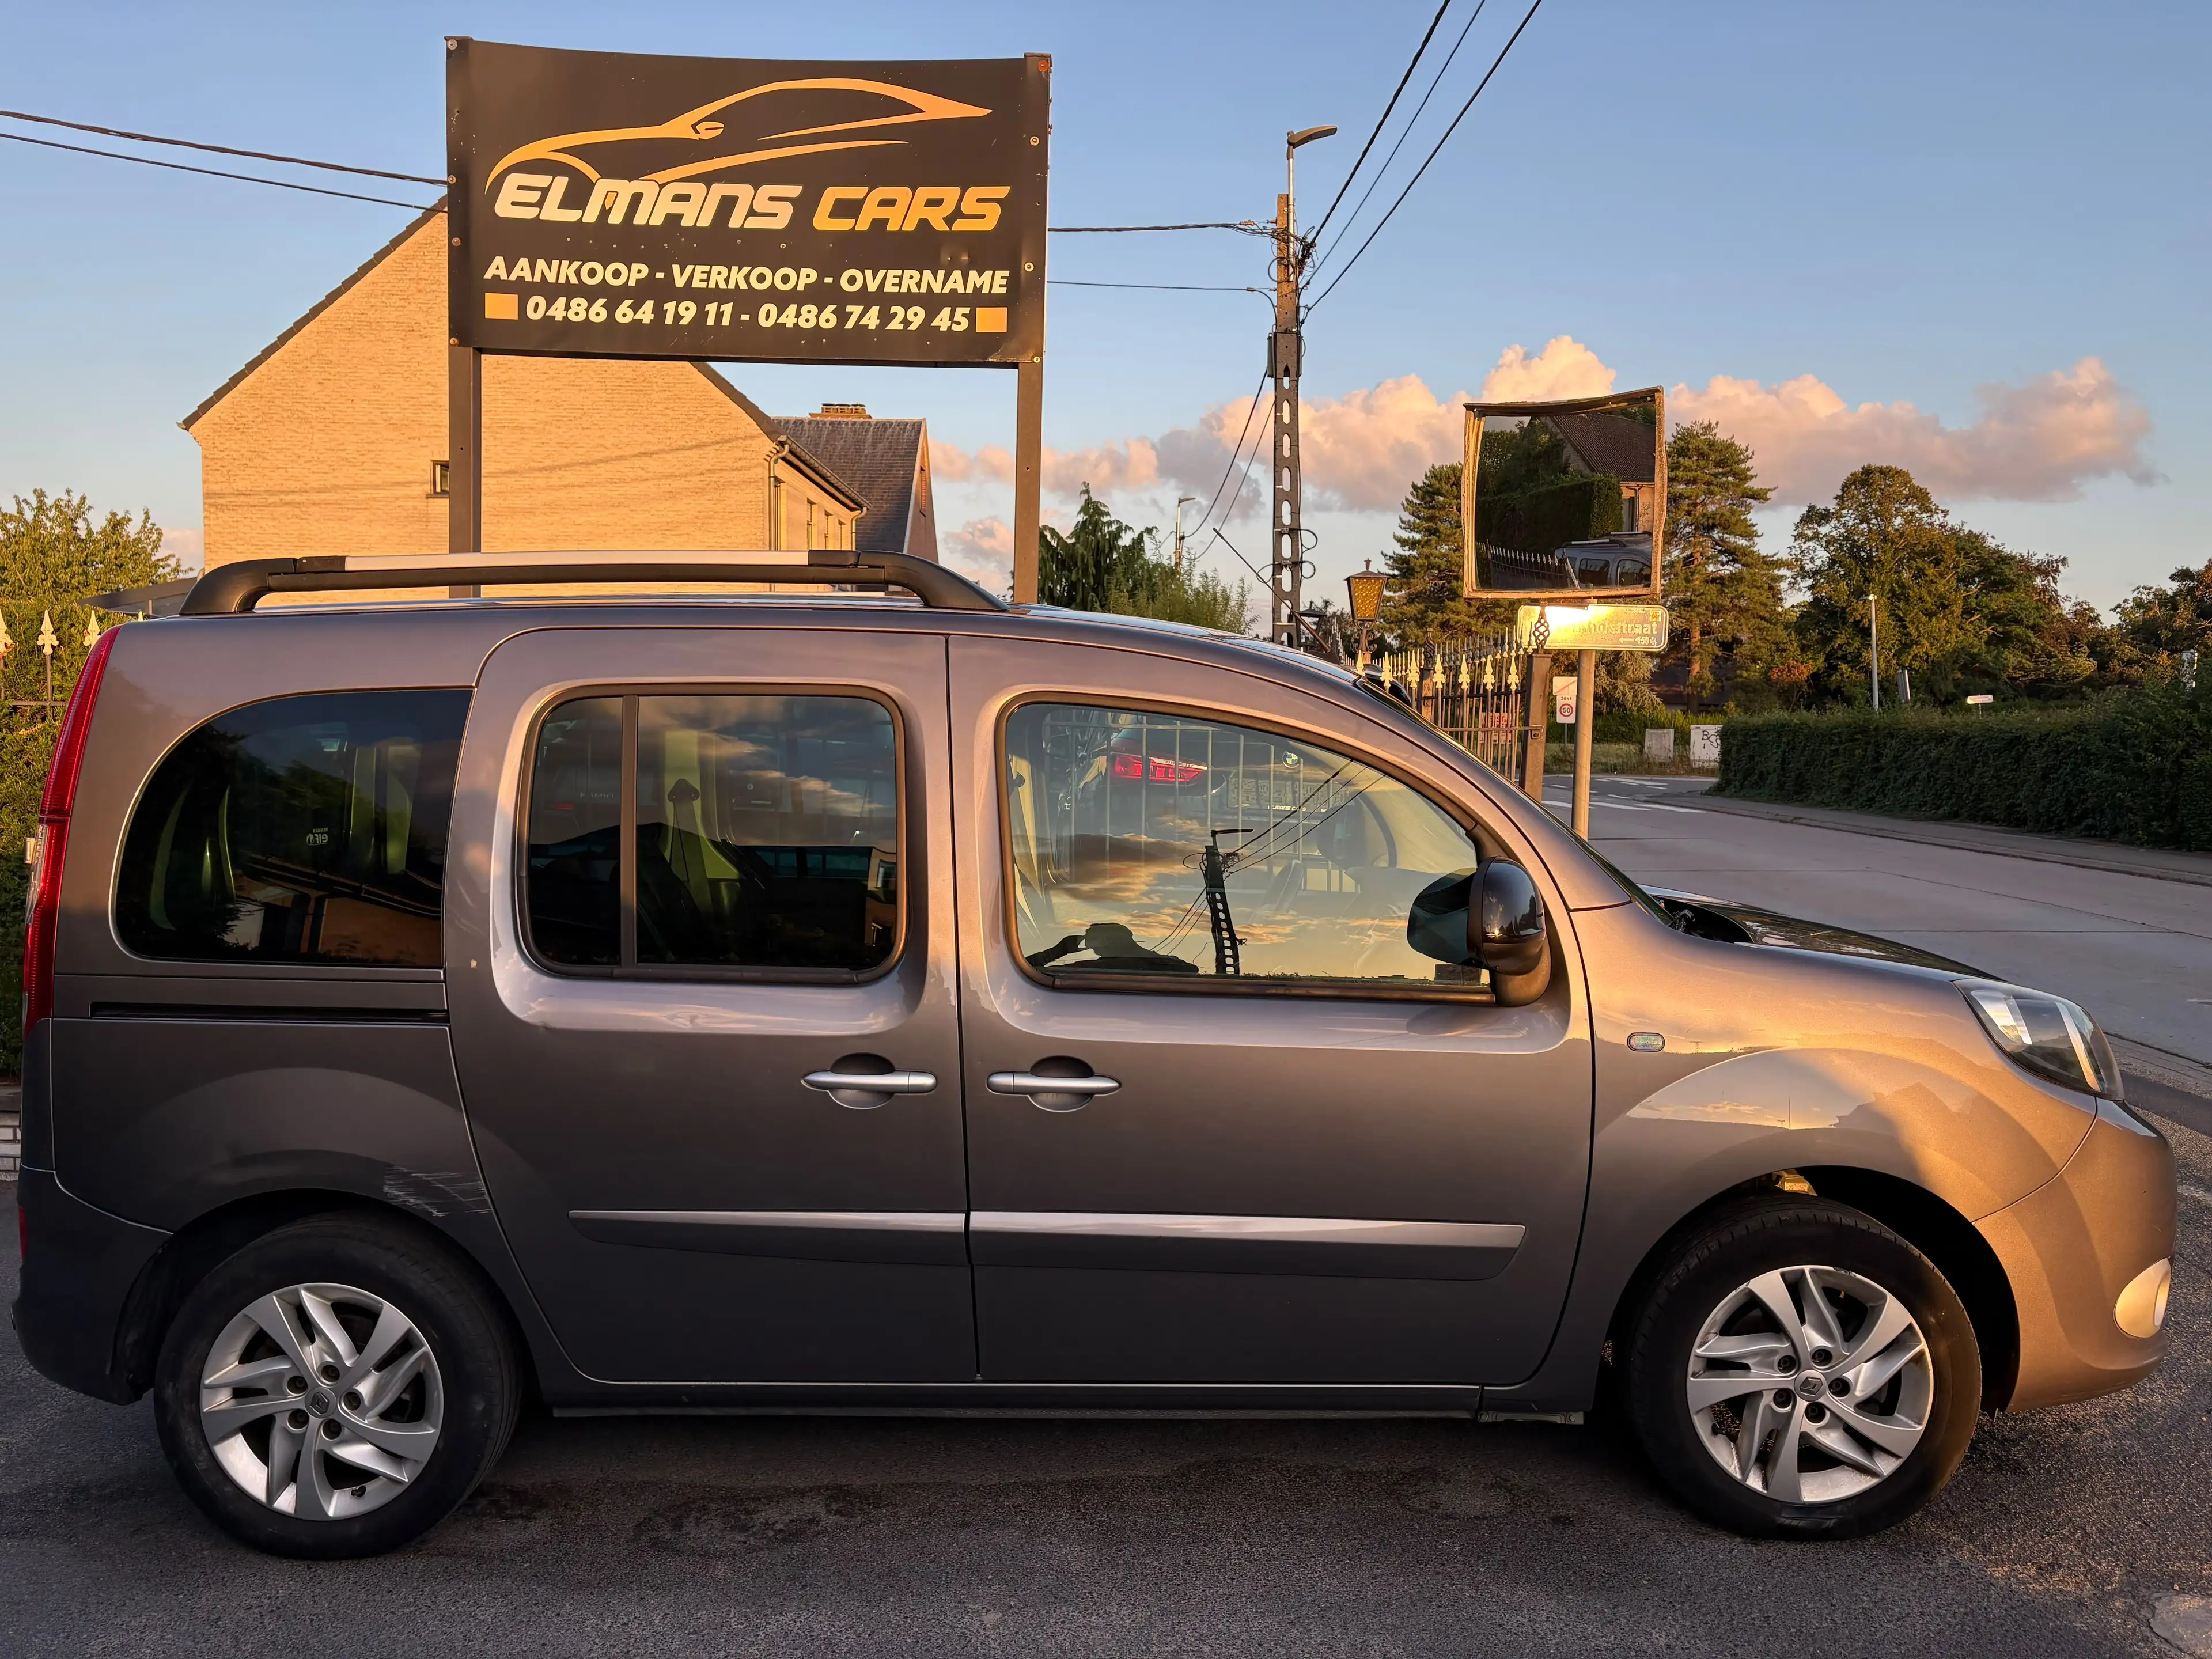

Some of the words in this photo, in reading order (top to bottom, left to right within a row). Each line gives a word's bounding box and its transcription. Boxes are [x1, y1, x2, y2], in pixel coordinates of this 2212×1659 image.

[494, 172, 803, 229] ELMANS
[812, 186, 1010, 231] CARS
[483, 256, 649, 287] AANKOOP
[671, 264, 818, 291] VERKOOP
[839, 268, 1010, 294] OVERNAME
[525, 295, 608, 323] 0486
[614, 299, 655, 324] 64
[662, 300, 697, 325] 19
[704, 301, 734, 327] 11
[757, 302, 838, 329] 0486
[843, 305, 880, 329] 74
[885, 305, 926, 331] 29
[930, 306, 971, 332] 45
